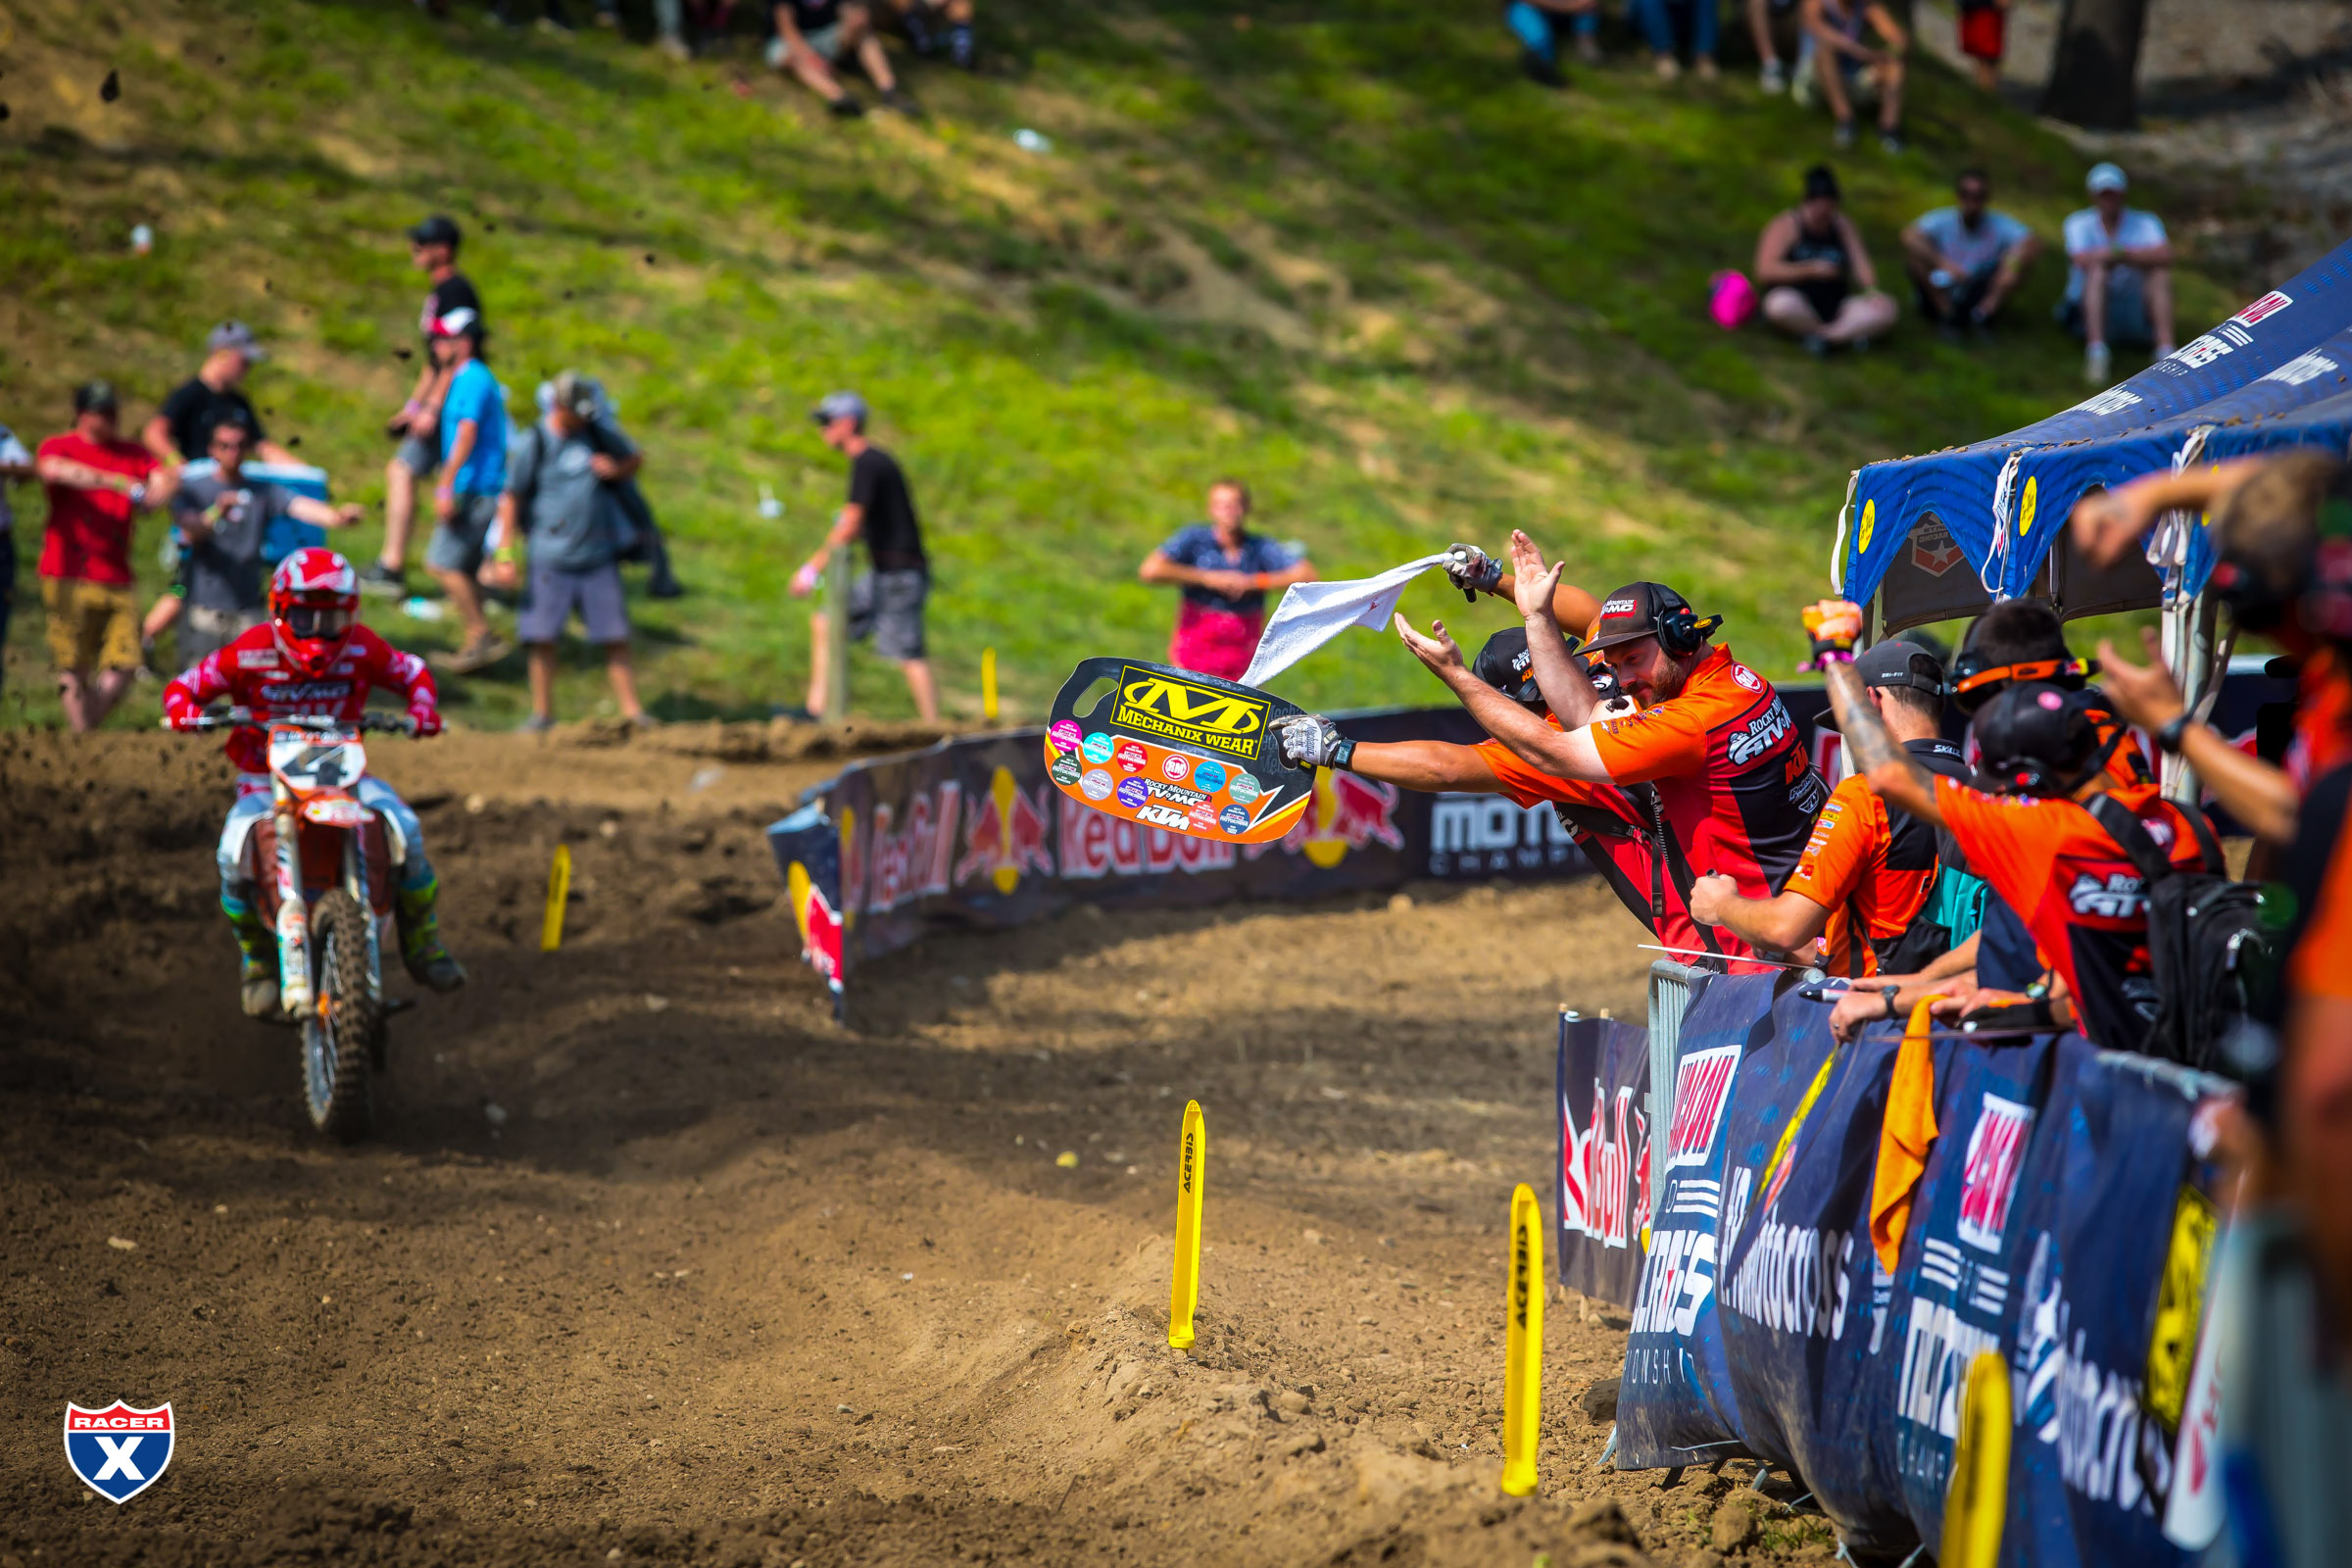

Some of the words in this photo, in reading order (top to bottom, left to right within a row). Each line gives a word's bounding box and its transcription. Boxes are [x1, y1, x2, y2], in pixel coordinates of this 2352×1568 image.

[1116, 705, 1203, 743] MECHANIX
[1206, 733, 1253, 756] WEAR
[1748, 708, 1775, 736] ROCKY
[1145, 778, 1168, 790] ROCKY
[1167, 783, 1207, 800] MOUNTAIN
[1135, 804, 1190, 831] KTM
[1183, 1132, 1194, 1194] ACERBIS
[1515, 1224, 1529, 1331] ACERBIS
